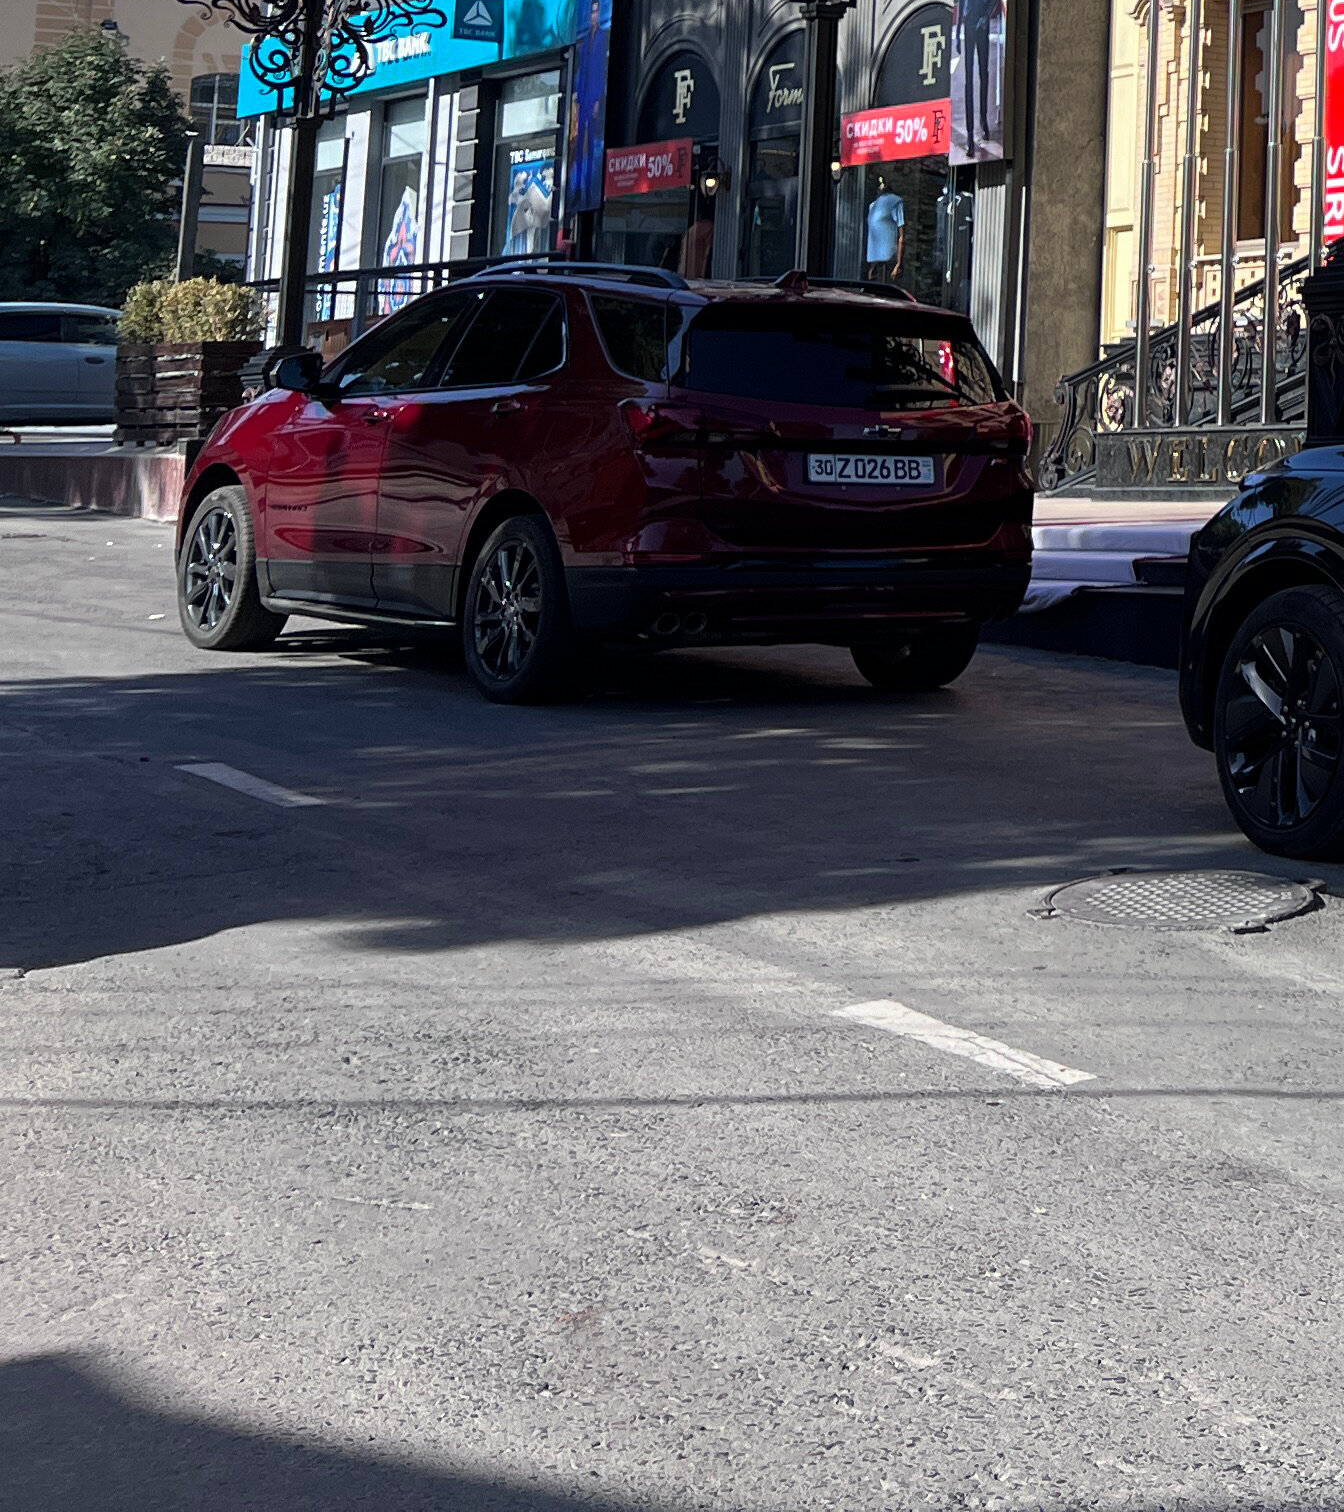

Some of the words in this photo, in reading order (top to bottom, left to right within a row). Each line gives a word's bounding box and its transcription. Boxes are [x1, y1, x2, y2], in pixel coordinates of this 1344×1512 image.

[377, 39, 396, 63] TBC
[846, 116, 893, 139] СКИДКИ
[895, 116, 928, 144] 50%
[608, 153, 647, 173] СКИДКИ
[647, 152, 674, 178] 50%
